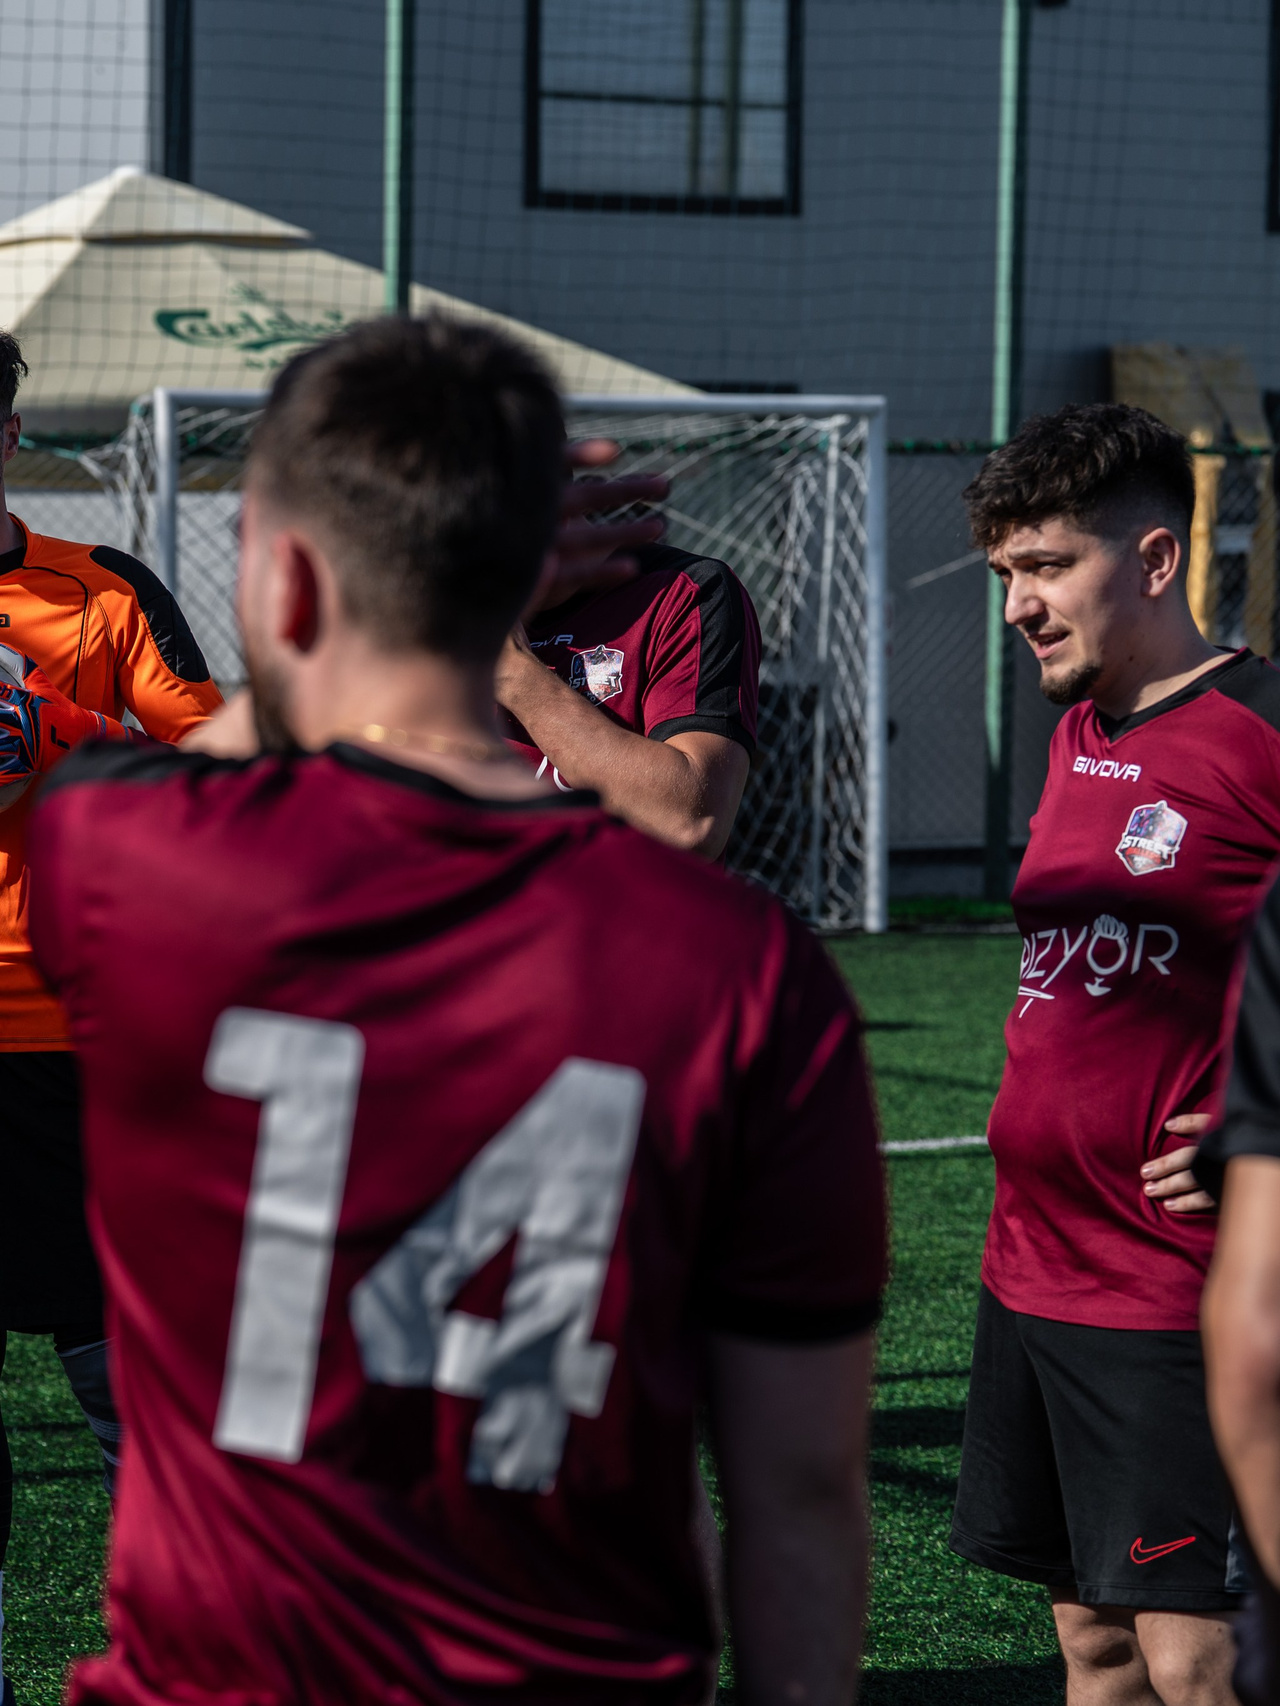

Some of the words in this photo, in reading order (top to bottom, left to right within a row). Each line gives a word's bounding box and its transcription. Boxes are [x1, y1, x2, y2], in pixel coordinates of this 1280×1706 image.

[1072, 755, 1142, 783] GIVOVA
[1121, 835, 1172, 860] STREET
[203, 1005, 647, 1495] 14
